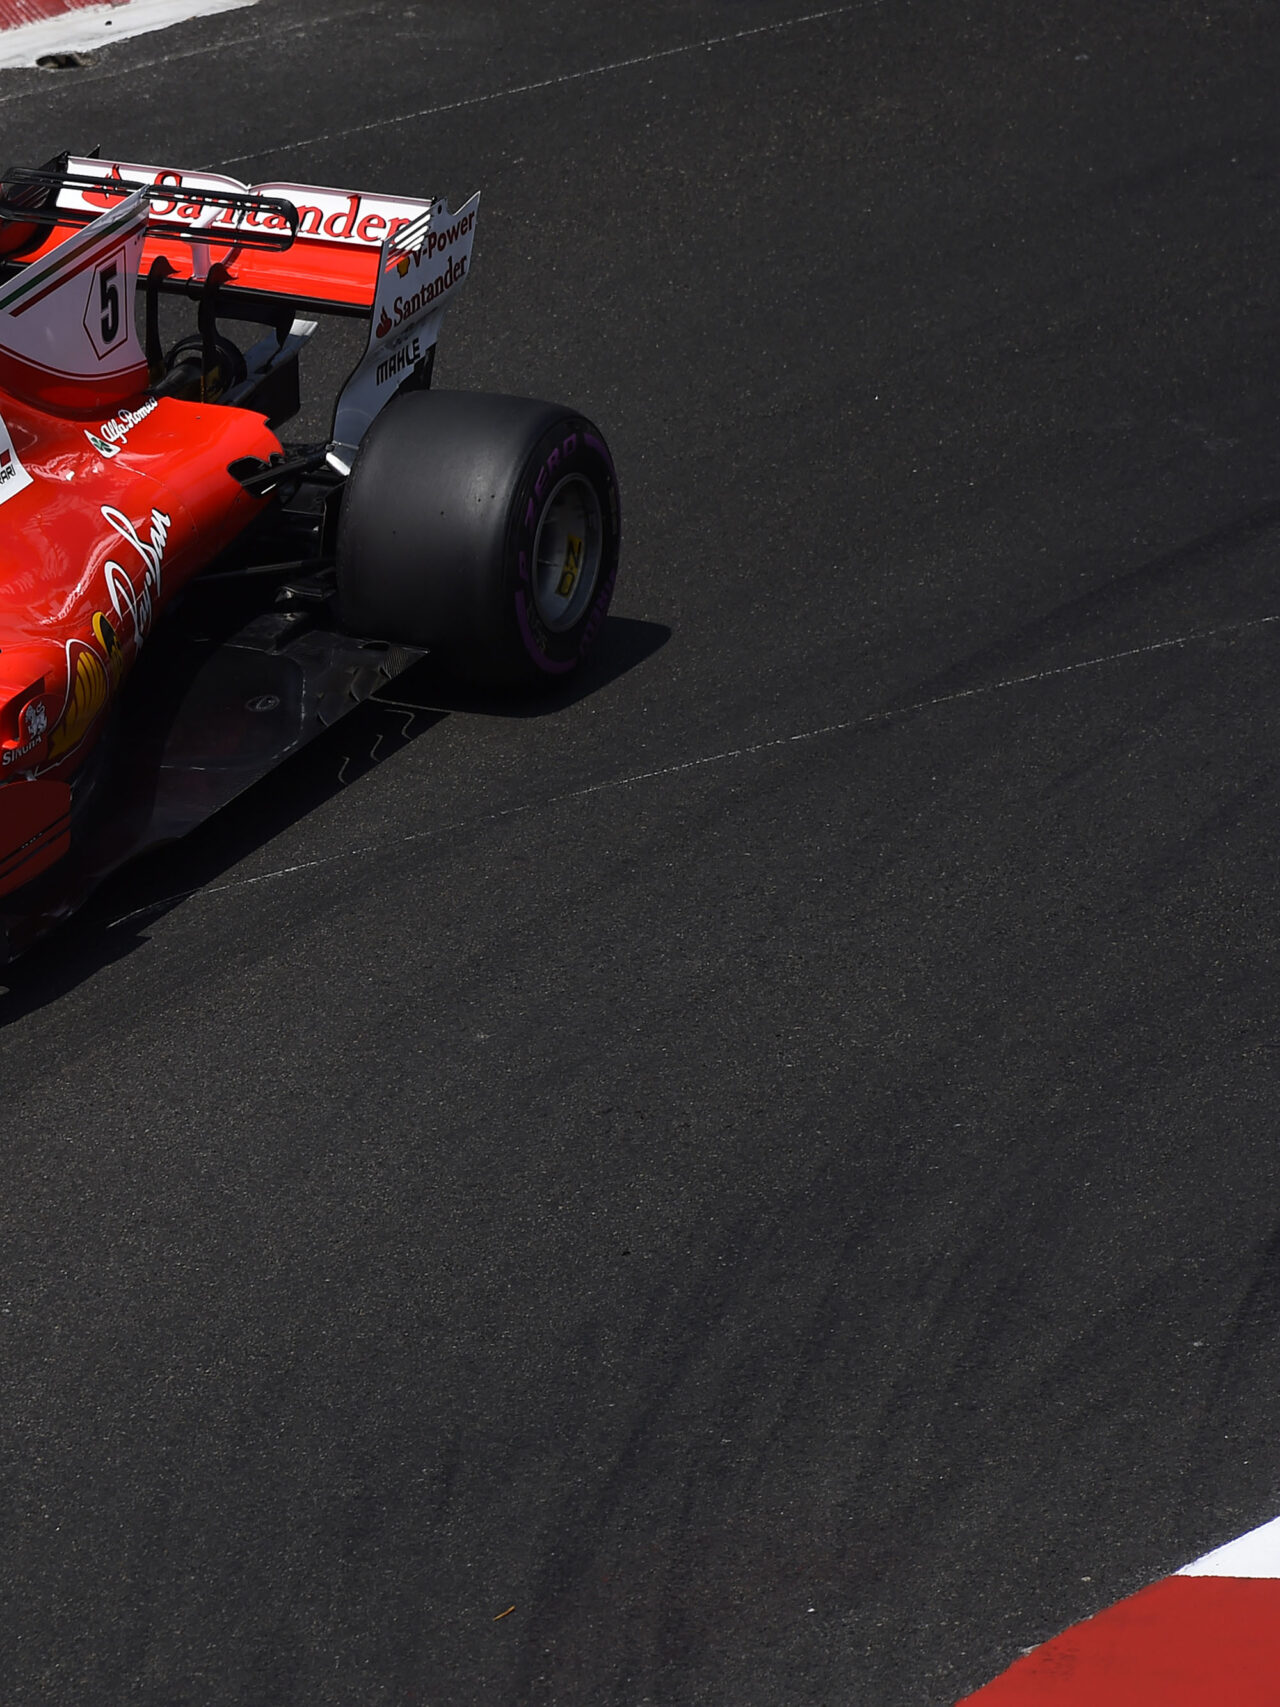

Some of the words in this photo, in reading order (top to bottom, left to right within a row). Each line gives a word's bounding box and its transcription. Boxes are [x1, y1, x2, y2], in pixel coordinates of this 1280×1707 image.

[99, 261, 119, 344] 5
[393, 254, 468, 327] Santander
[376, 338, 420, 386] MAHLE
[100, 418, 129, 444] Alfa
[118, 397, 158, 428] Romeo
